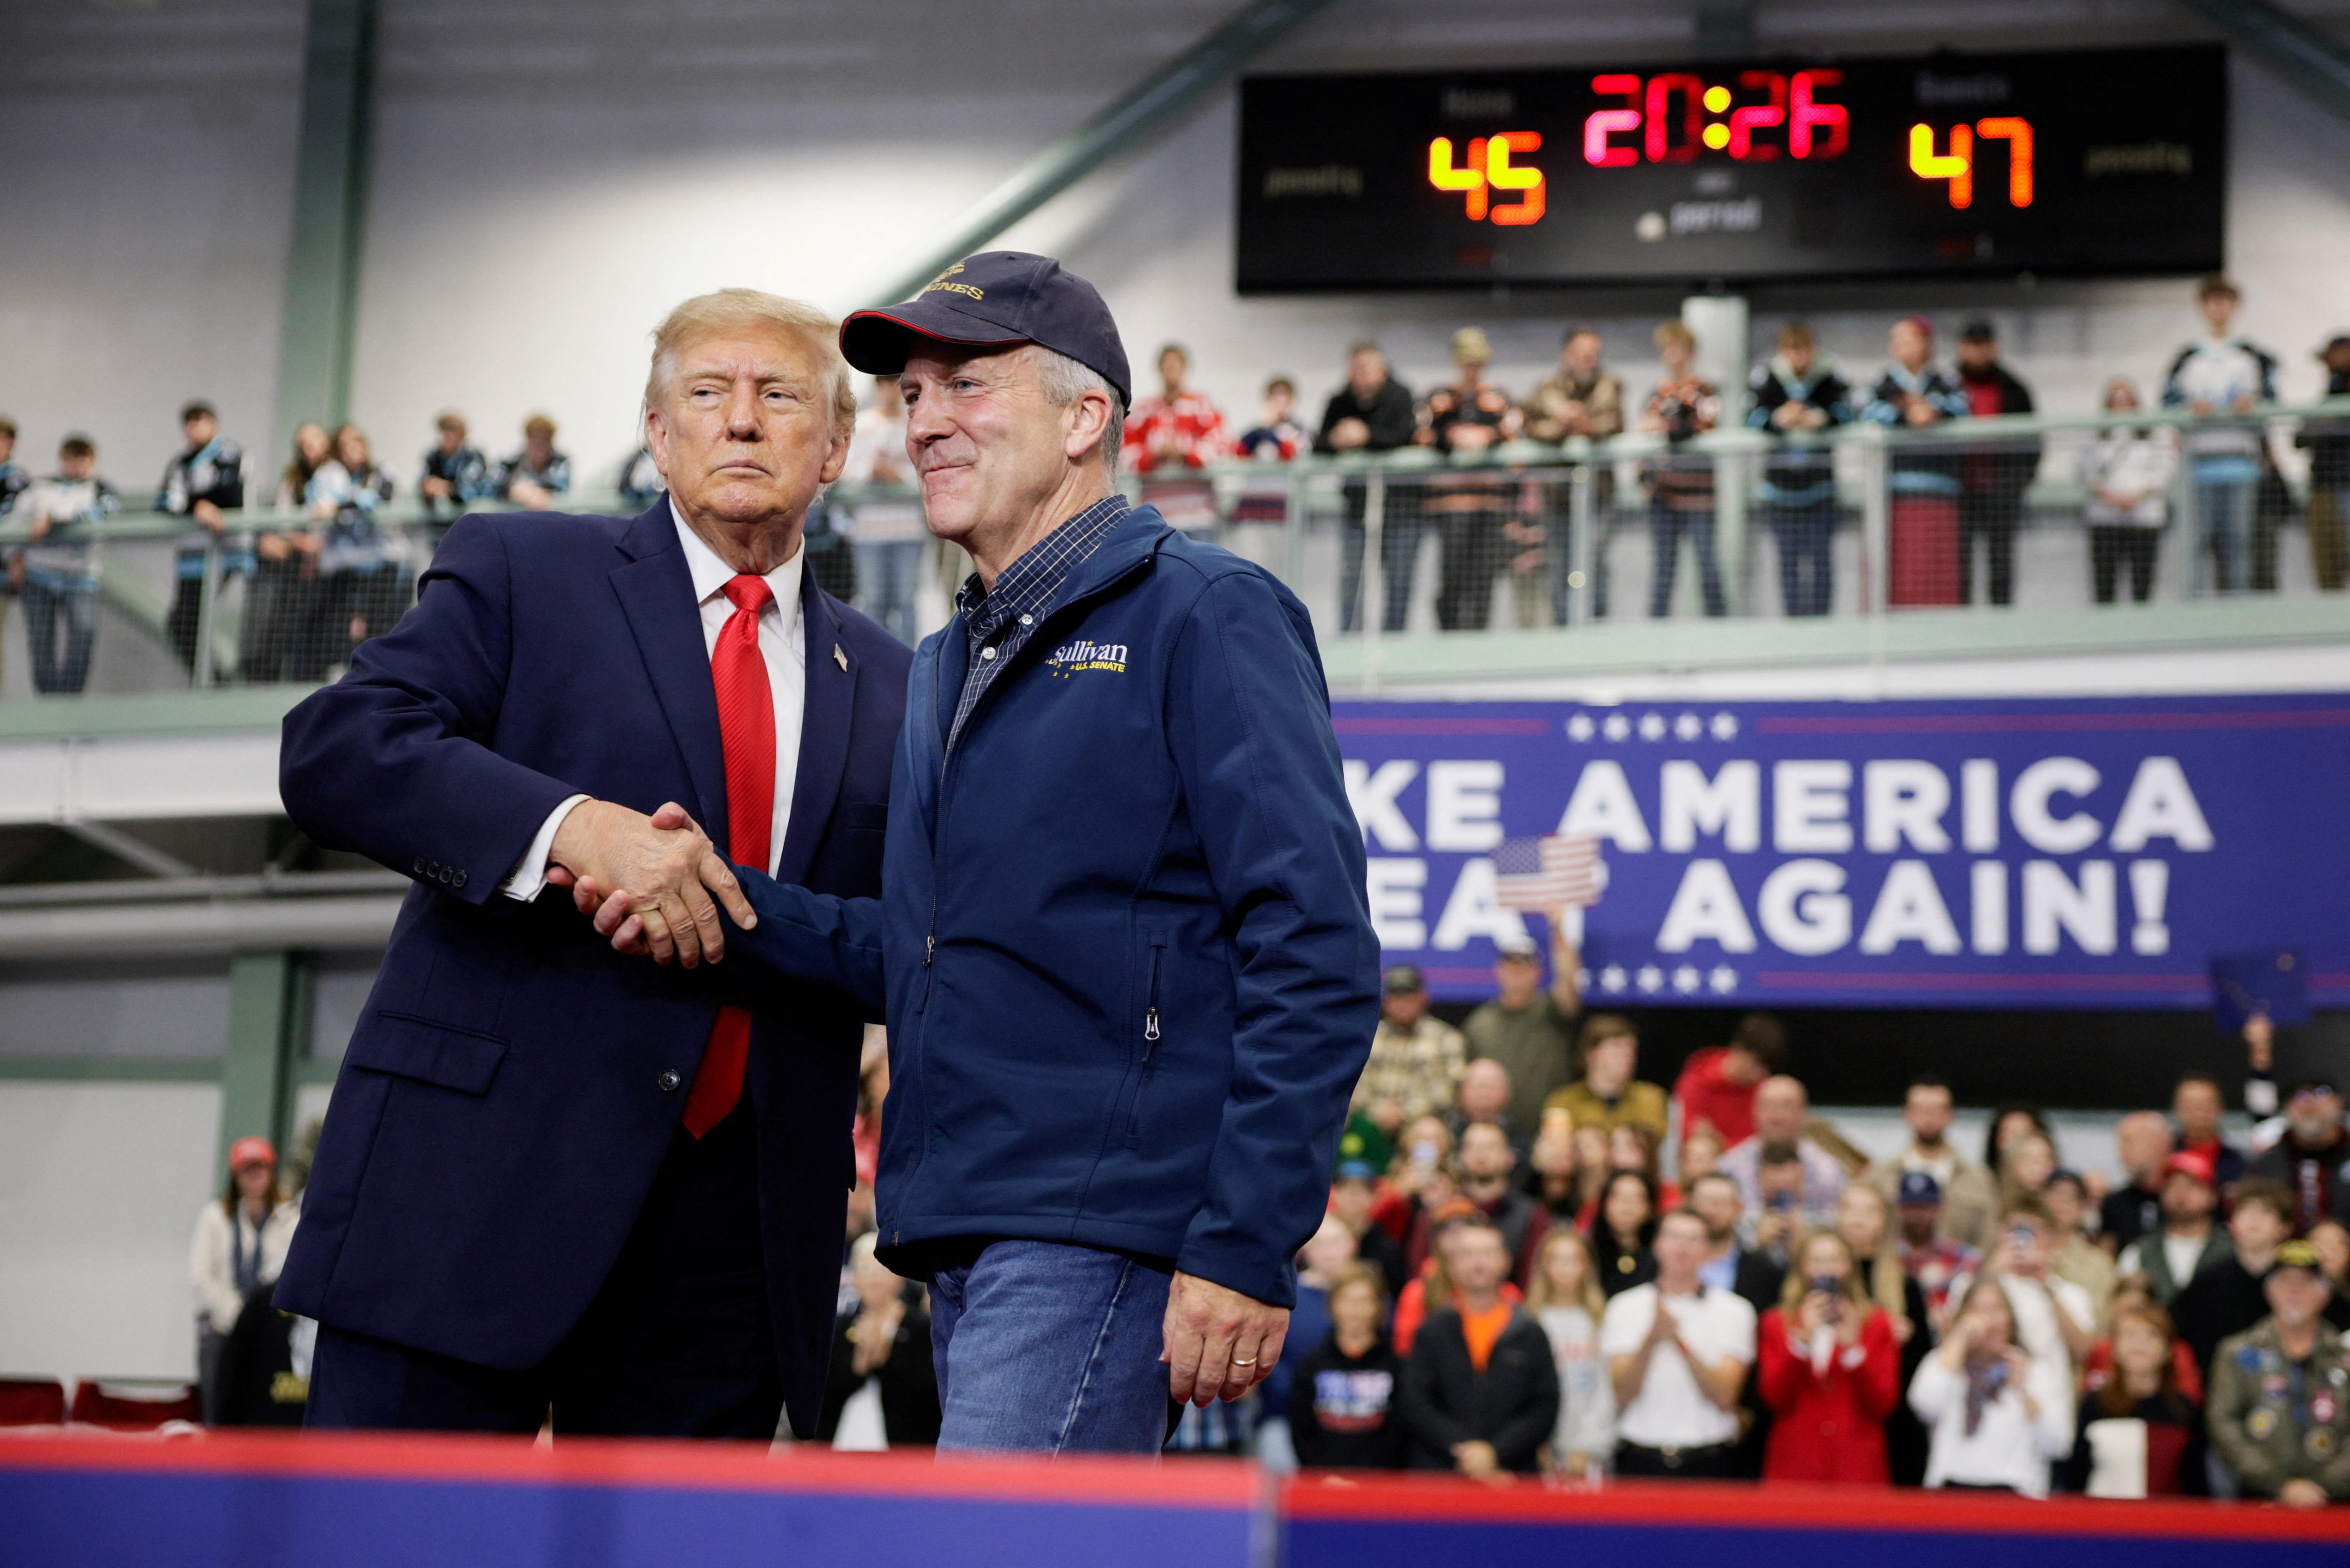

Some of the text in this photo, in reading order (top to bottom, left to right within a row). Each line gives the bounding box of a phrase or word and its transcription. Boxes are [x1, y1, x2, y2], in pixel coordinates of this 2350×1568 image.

[1584, 68, 1851, 168] 20:26
[1910, 117, 2034, 209] 47
[1430, 131, 1546, 226] 45
[1075, 661, 1126, 672] U.S. SENATE
[1342, 756, 2217, 854] KE AMERICA
[1654, 857, 2170, 955] AGAIN!
